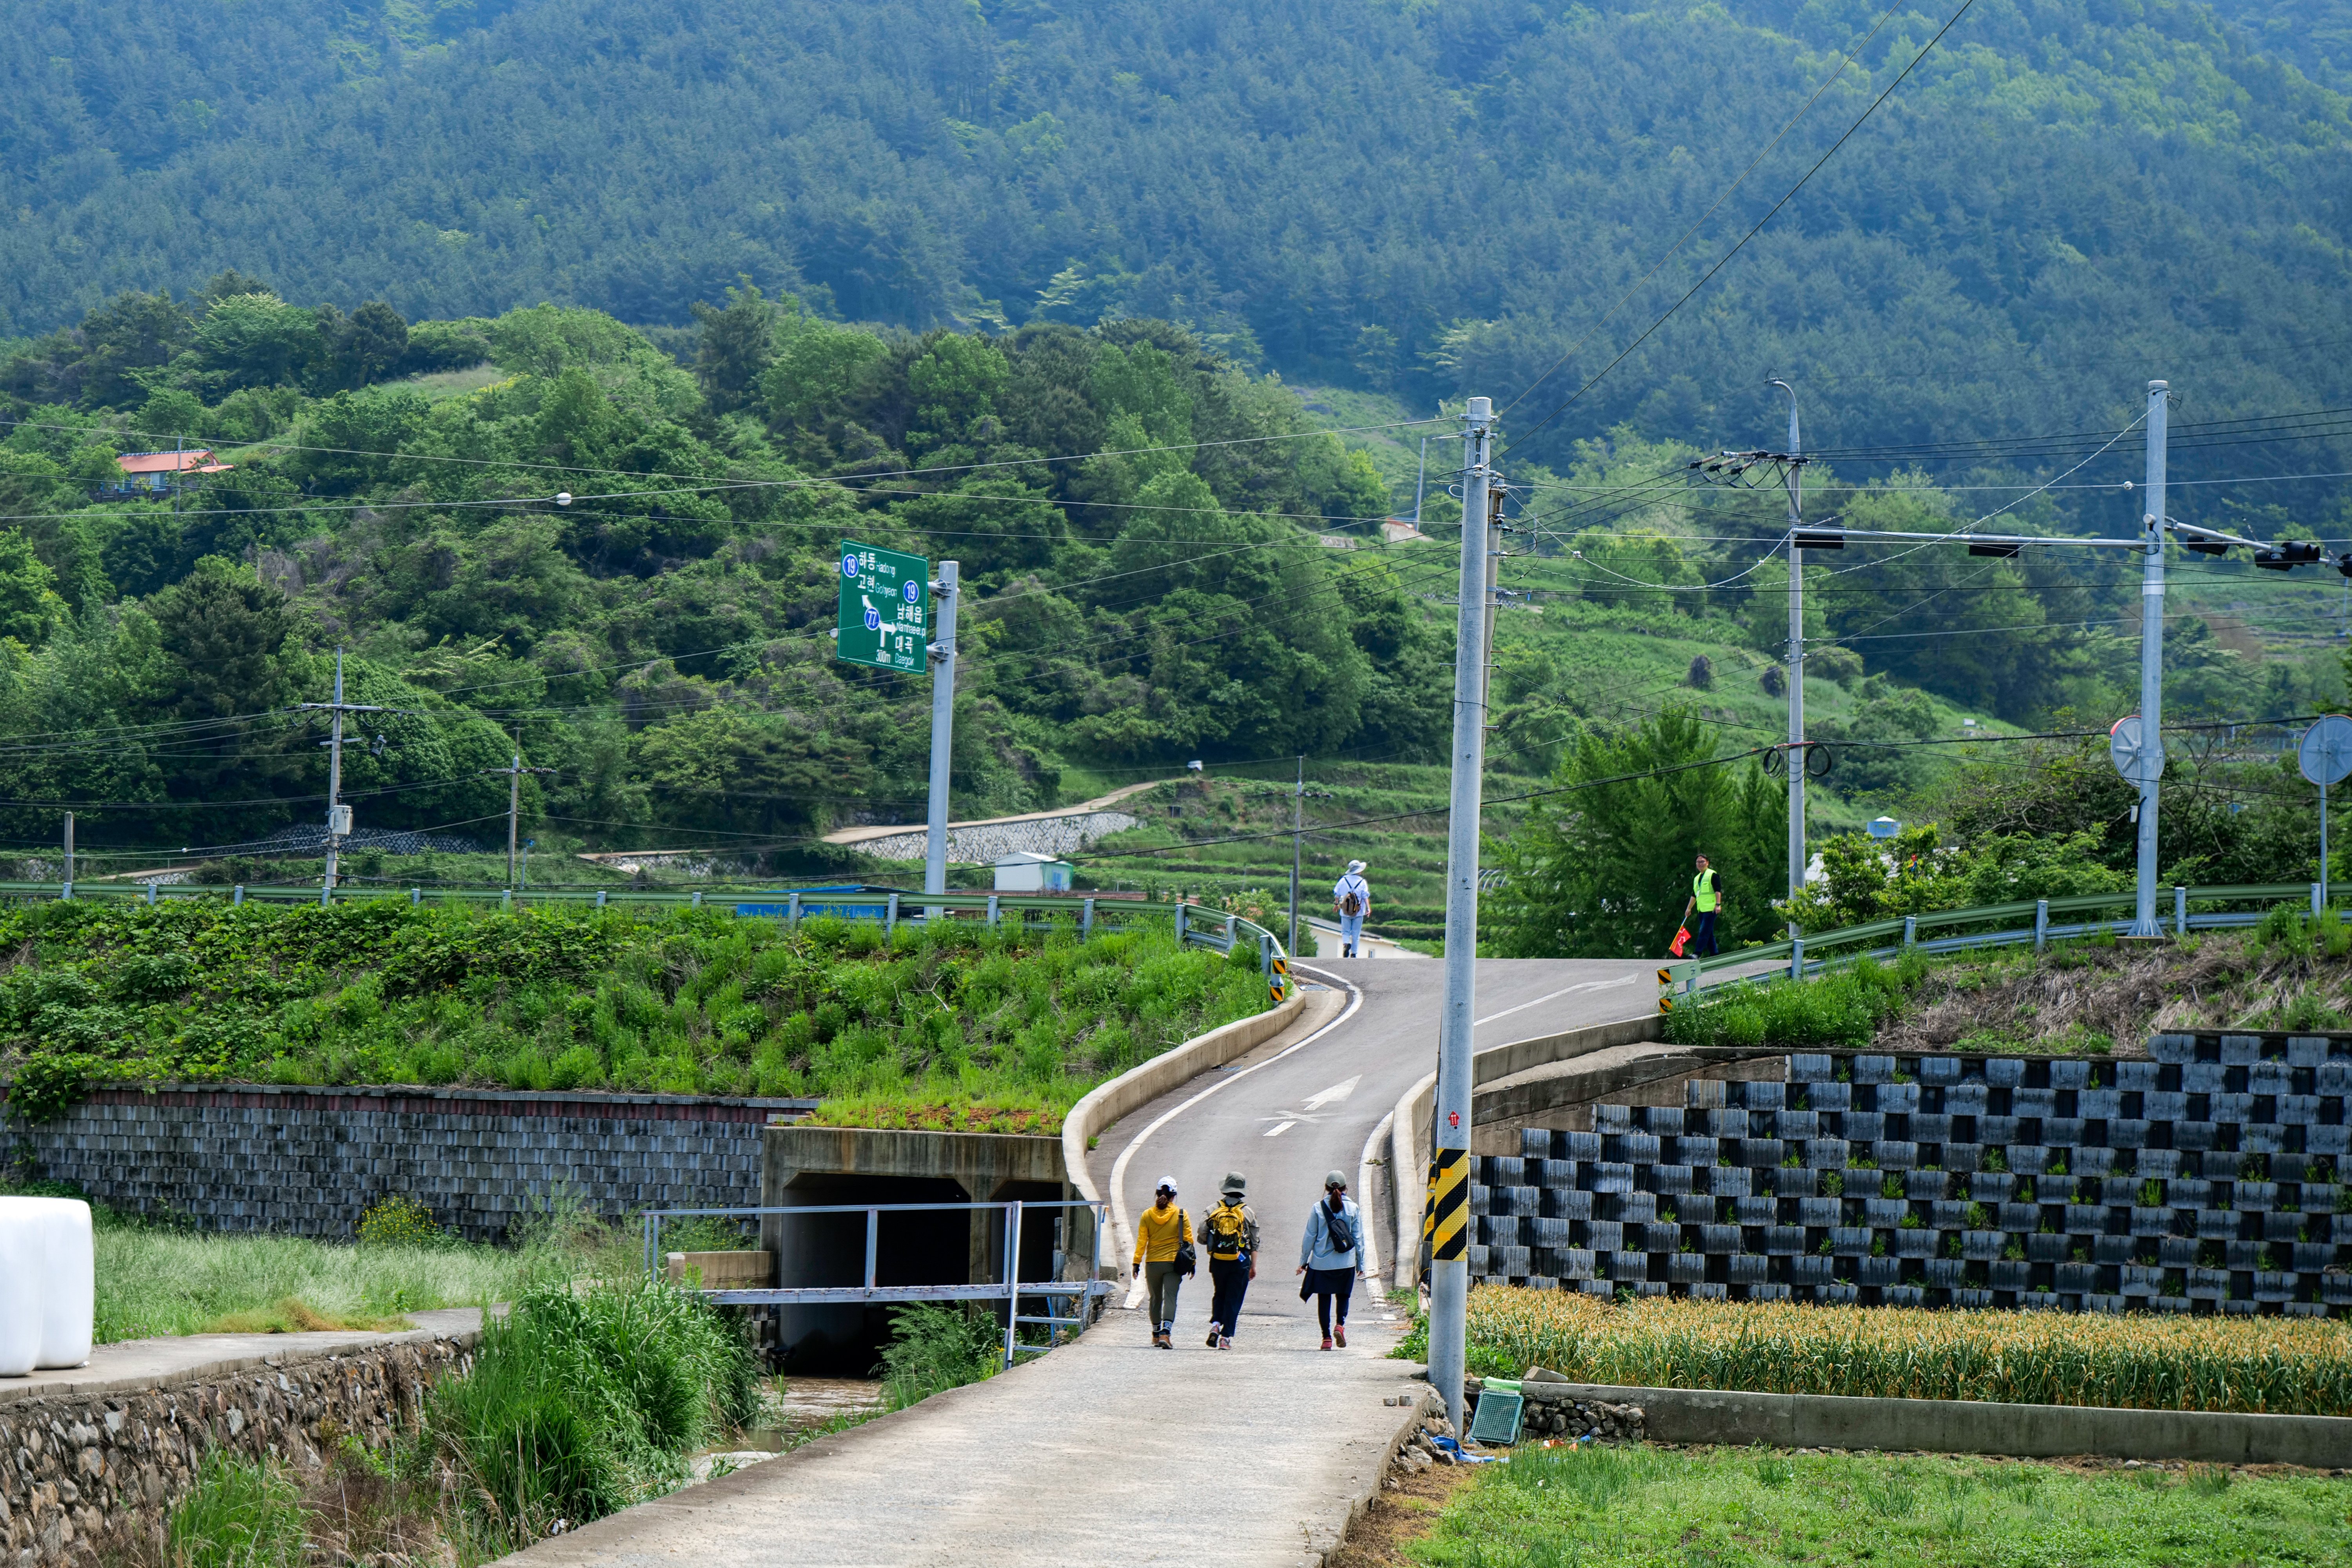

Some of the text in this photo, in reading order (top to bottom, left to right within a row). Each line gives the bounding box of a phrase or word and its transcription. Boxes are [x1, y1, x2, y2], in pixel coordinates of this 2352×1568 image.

[847, 558, 855, 574] 19
[858, 551, 876, 570] 하동
[876, 561, 896, 578] Hadong
[857, 574, 875, 593] 고현
[875, 583, 897, 598] Gohyeon
[907, 584, 915, 600] 19
[868, 610, 877, 626] 77
[897, 603, 922, 623] 남해읍
[895, 635, 913, 654] 대곡
[876, 649, 891, 663] 300m
[895, 653, 914, 668] Daegok
